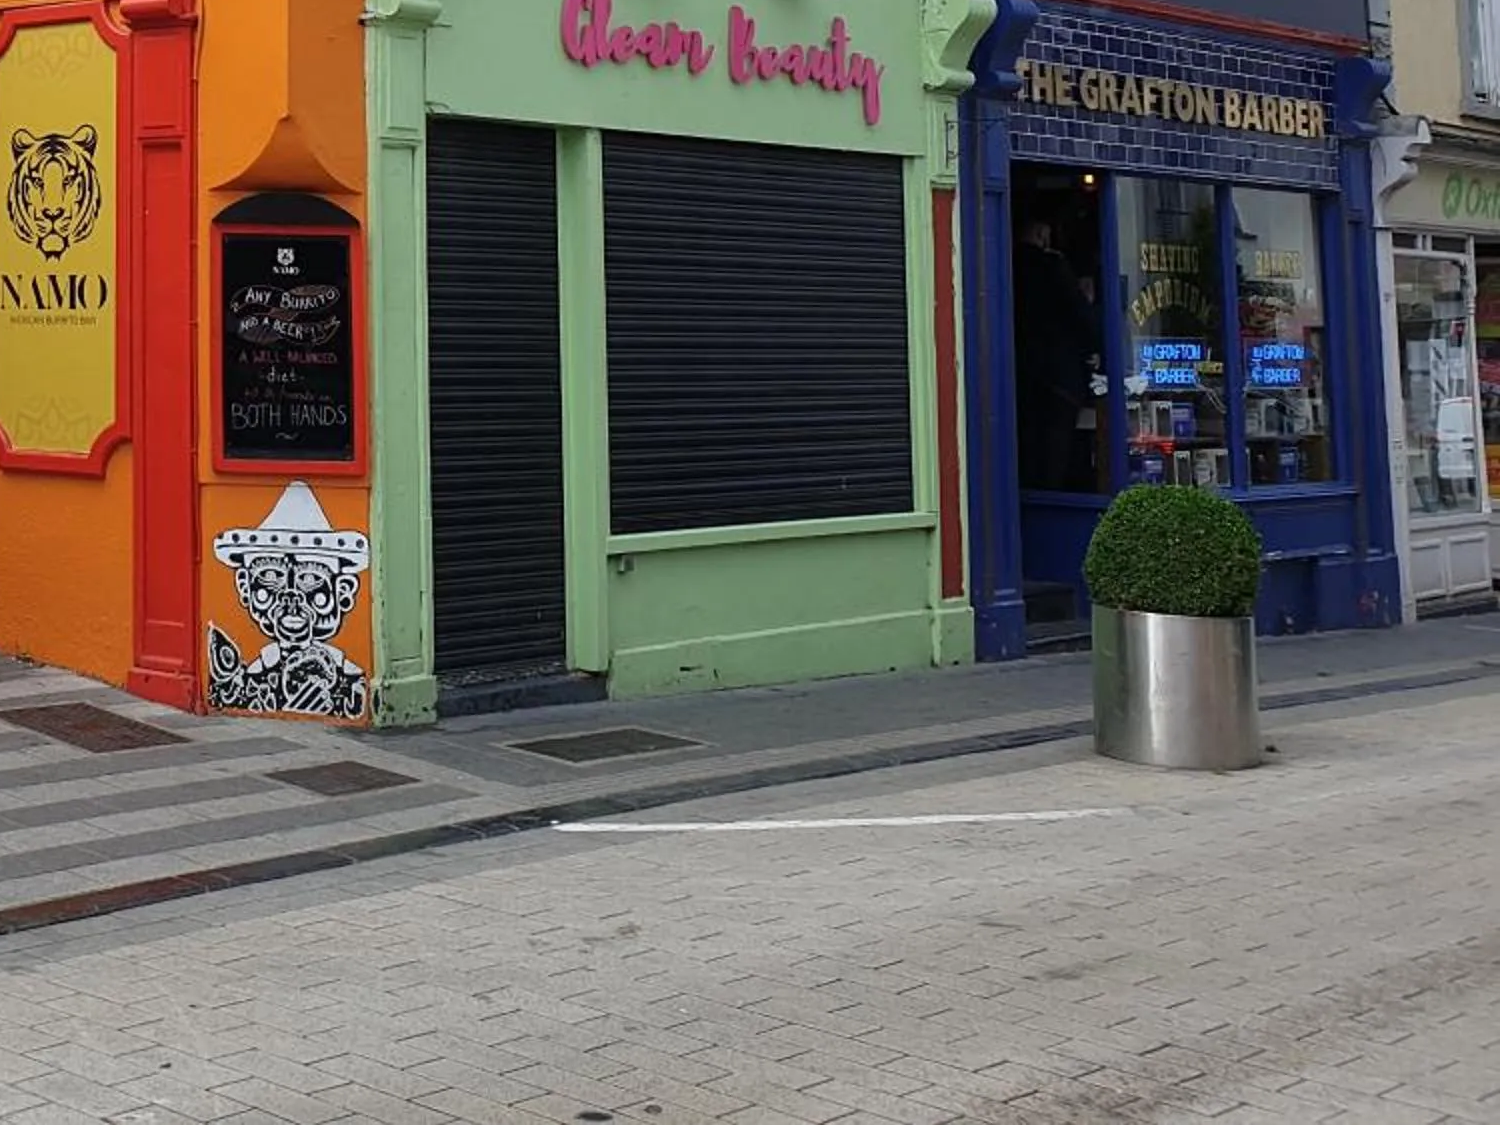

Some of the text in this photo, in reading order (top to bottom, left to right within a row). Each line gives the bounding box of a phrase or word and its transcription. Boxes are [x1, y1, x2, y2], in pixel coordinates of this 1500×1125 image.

[1015, 57, 1325, 138] THE GRAFTON BARBER
[1, 274, 107, 309] NAMO
[245, 287, 336, 309] ANY BURRITO
[231, 402, 347, 430] BOTH HANDS
